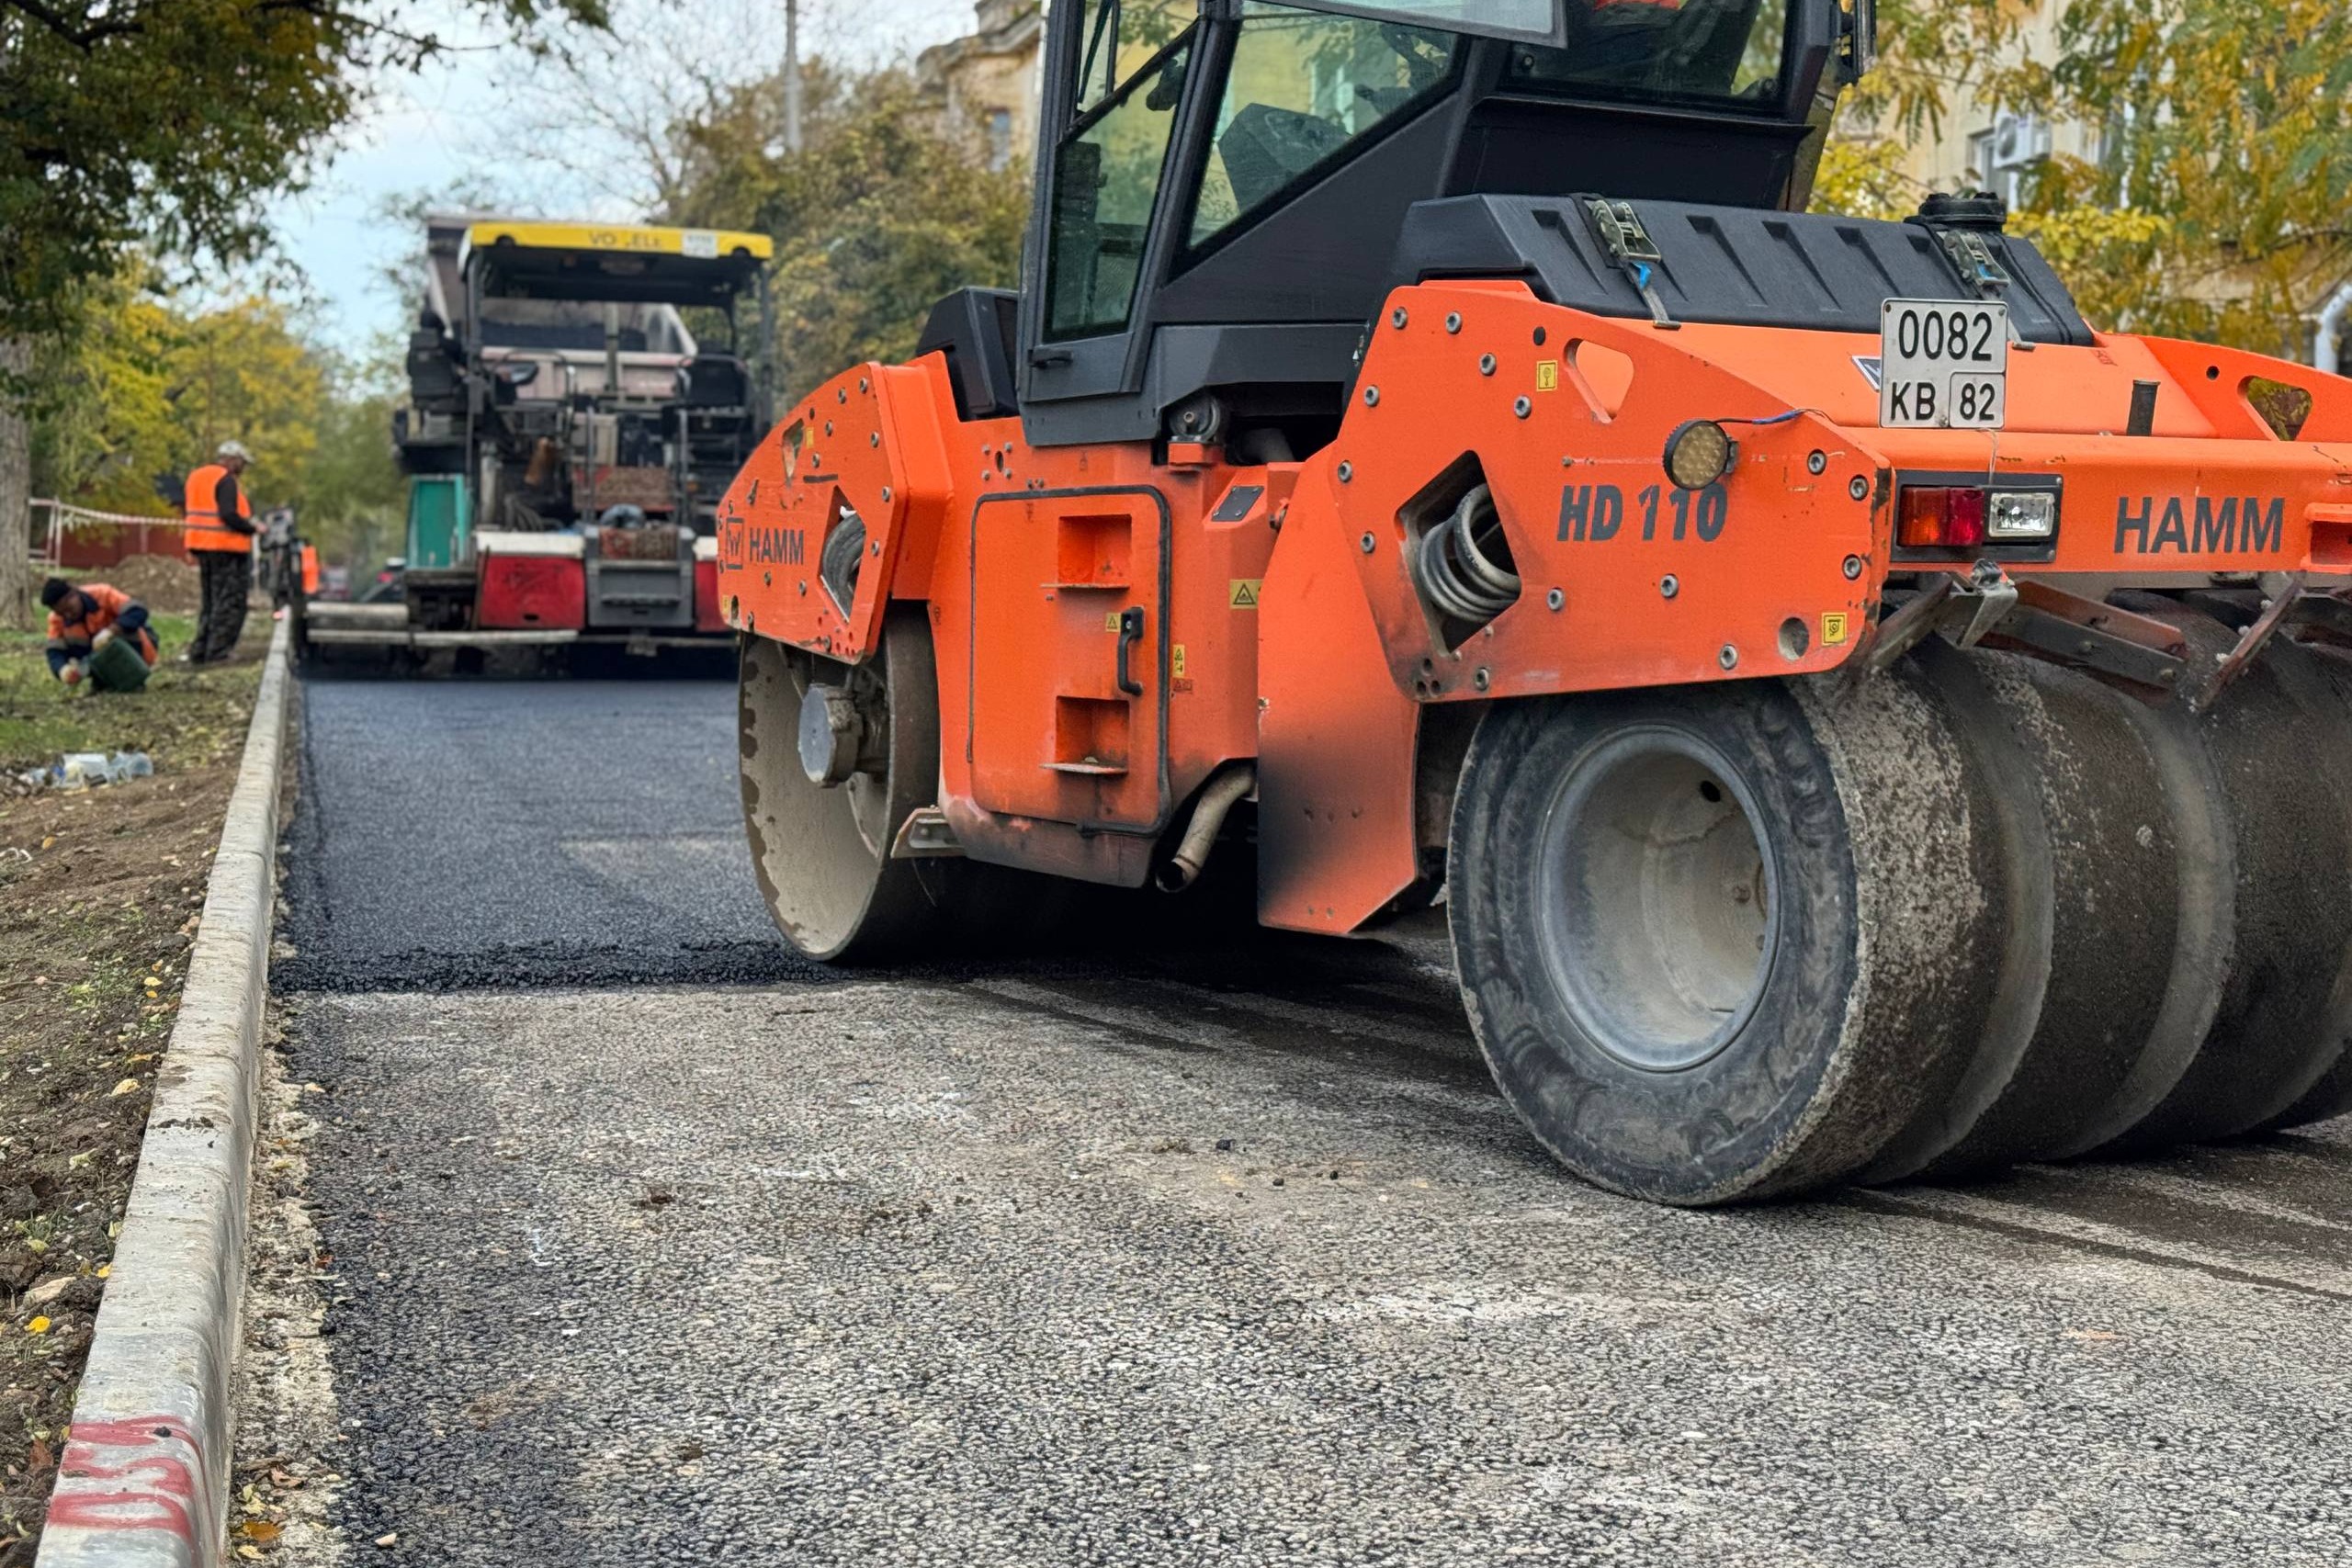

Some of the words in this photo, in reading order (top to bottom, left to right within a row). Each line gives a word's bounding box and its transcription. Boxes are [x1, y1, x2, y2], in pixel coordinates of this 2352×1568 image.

[1899, 310, 1992, 361] 0082
[1960, 383, 1996, 421] 82
[1556, 485, 1623, 542] HD
[1638, 482, 1727, 542] 110
[2114, 497, 2285, 553] HAMM
[750, 527, 804, 566] HAMM
